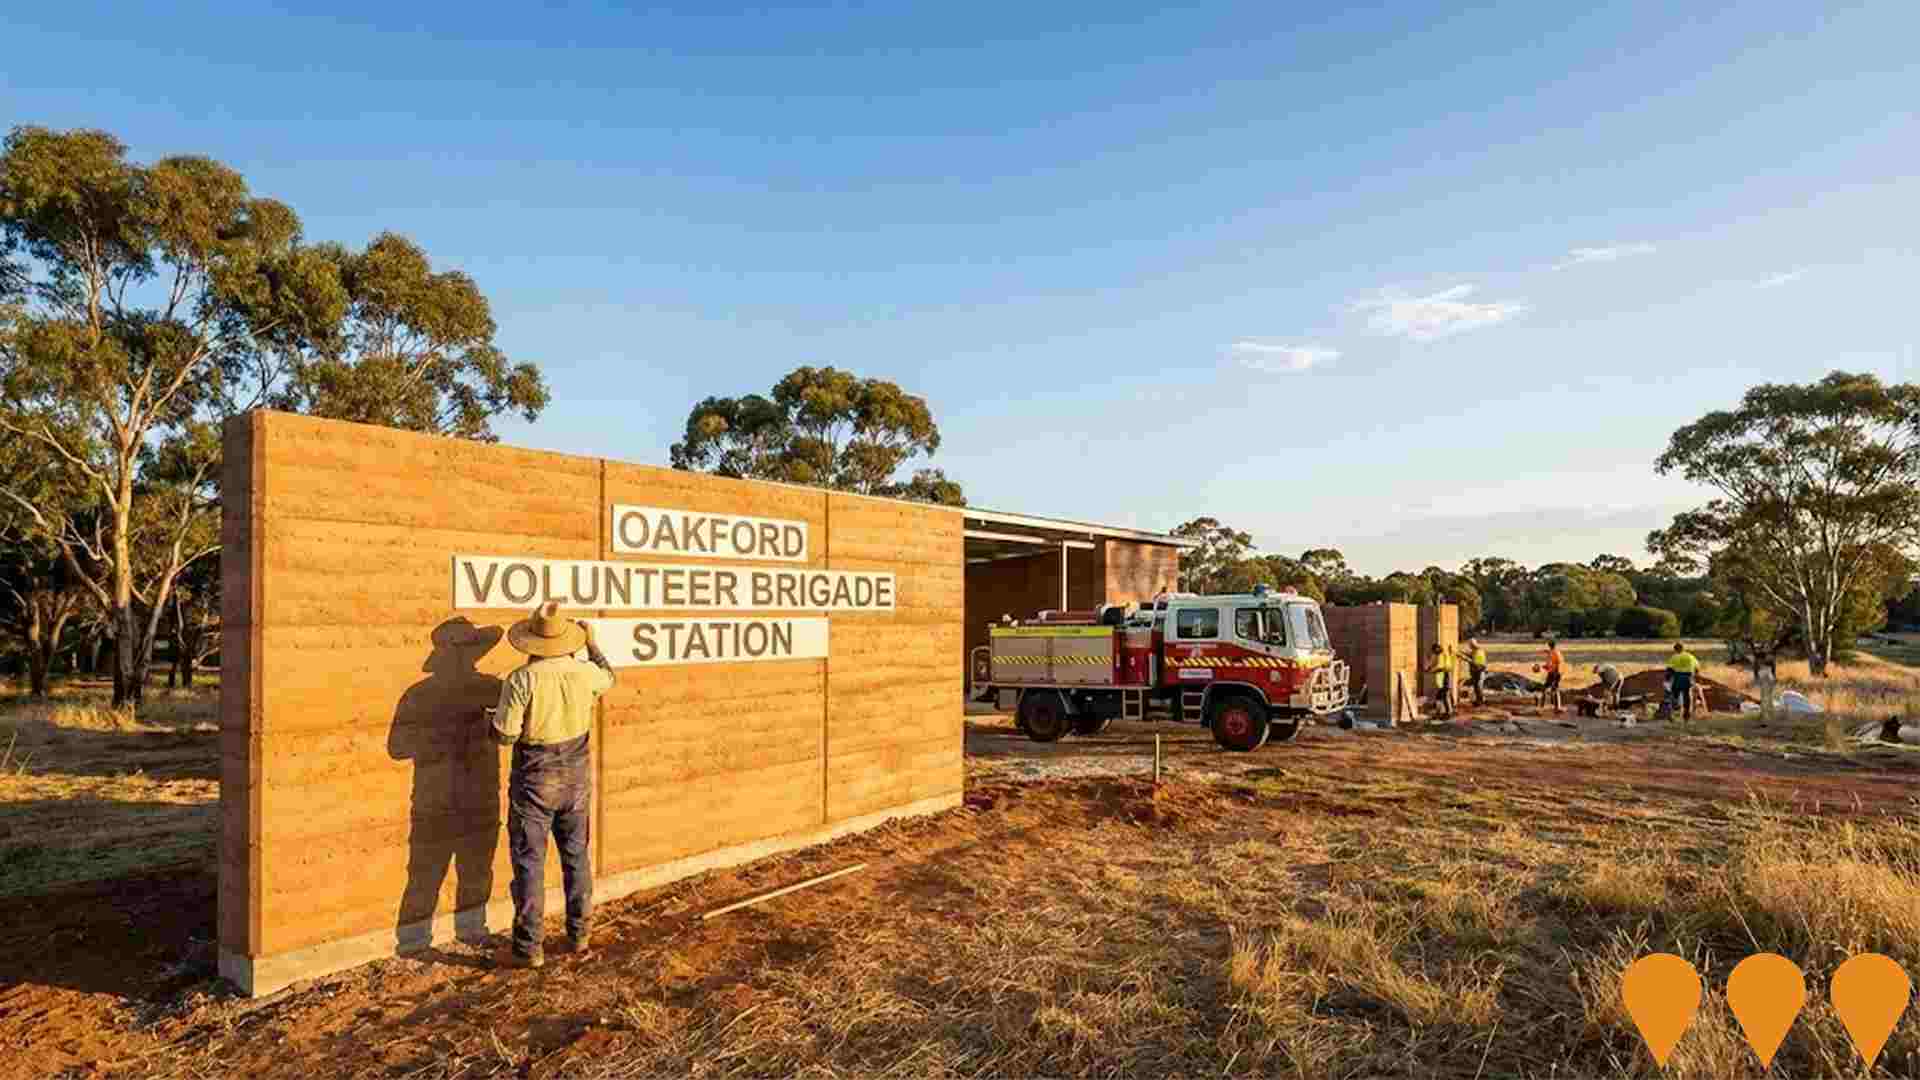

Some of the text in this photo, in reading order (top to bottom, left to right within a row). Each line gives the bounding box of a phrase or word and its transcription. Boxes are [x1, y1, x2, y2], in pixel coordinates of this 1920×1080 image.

[618, 511, 804, 557] OAKFORD
[463, 561, 892, 607] VOLUNTEER BRIGADE
[631, 621, 793, 661] STATION
